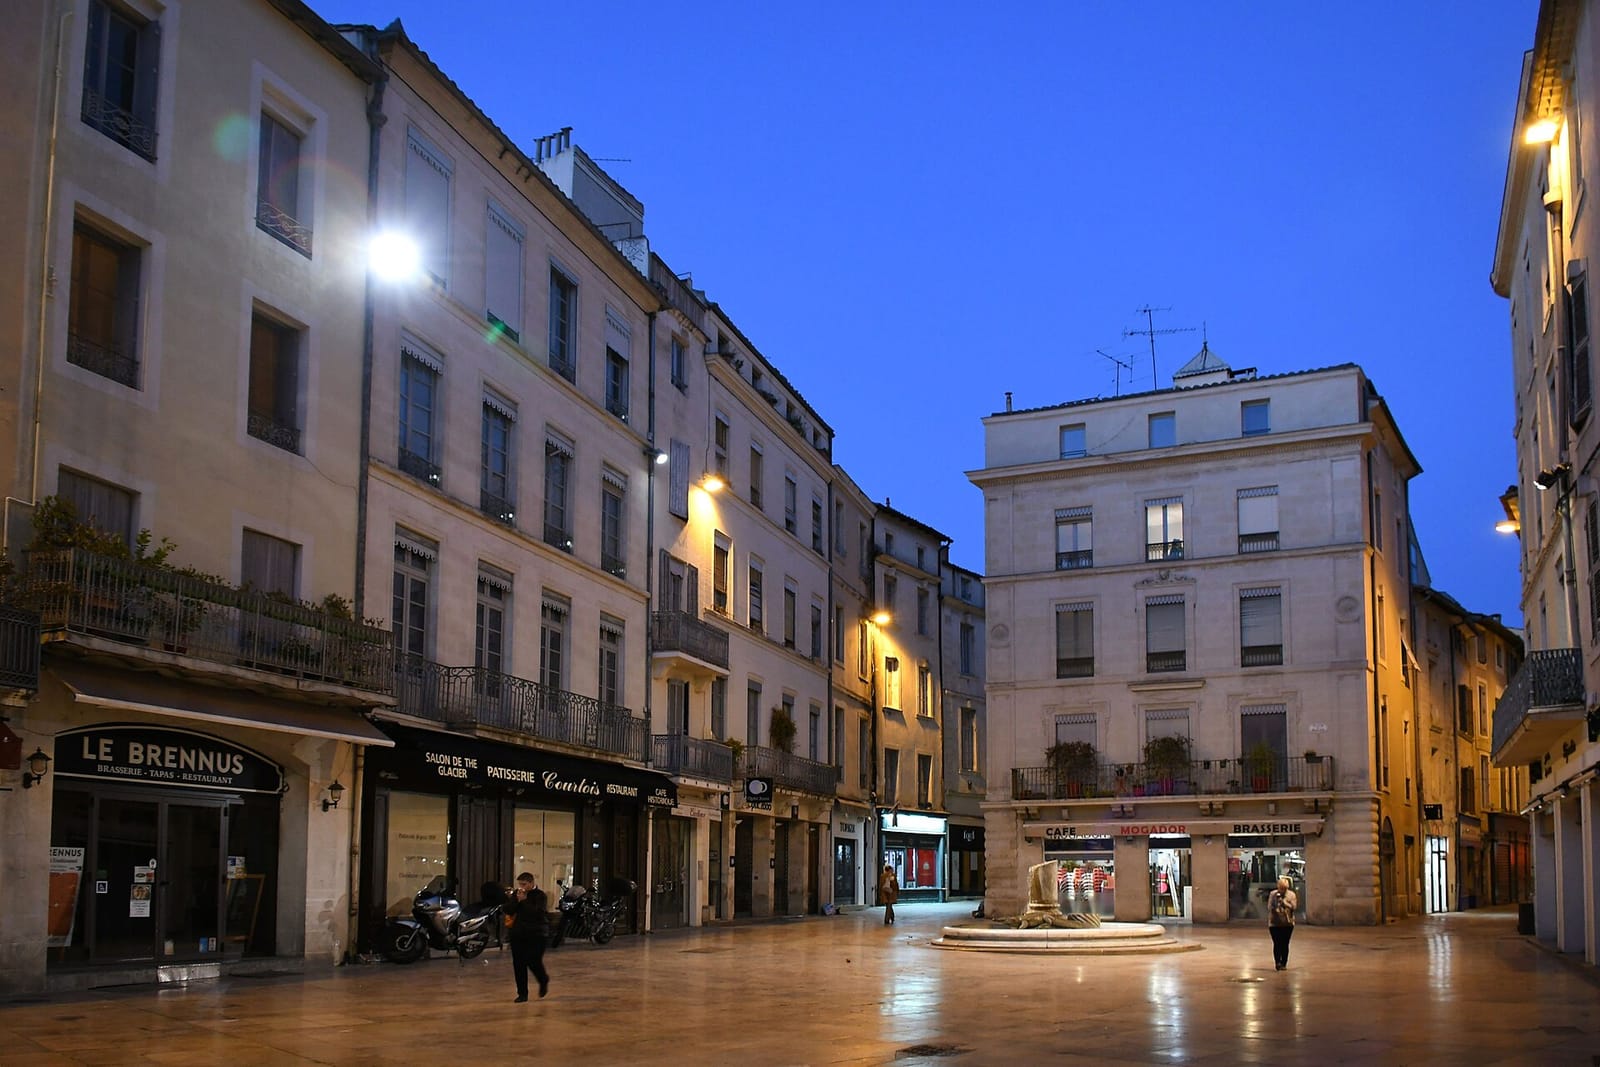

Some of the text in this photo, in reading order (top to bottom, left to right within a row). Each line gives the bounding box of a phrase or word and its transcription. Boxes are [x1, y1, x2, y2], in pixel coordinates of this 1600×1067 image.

[81, 735, 245, 776] LE BRENNUS
[425, 751, 478, 769] SALON DE THE
[97, 764, 233, 785] BRASSERIE TAPAS RESTAURANT
[438, 765, 468, 779] GLACIER
[487, 766, 536, 784] PATISSERIE
[541, 770, 600, 796] Courtois
[606, 783, 639, 798] RESTAURANT
[1046, 823, 1301, 836] CAFE MOGADOR BRASSERIE
